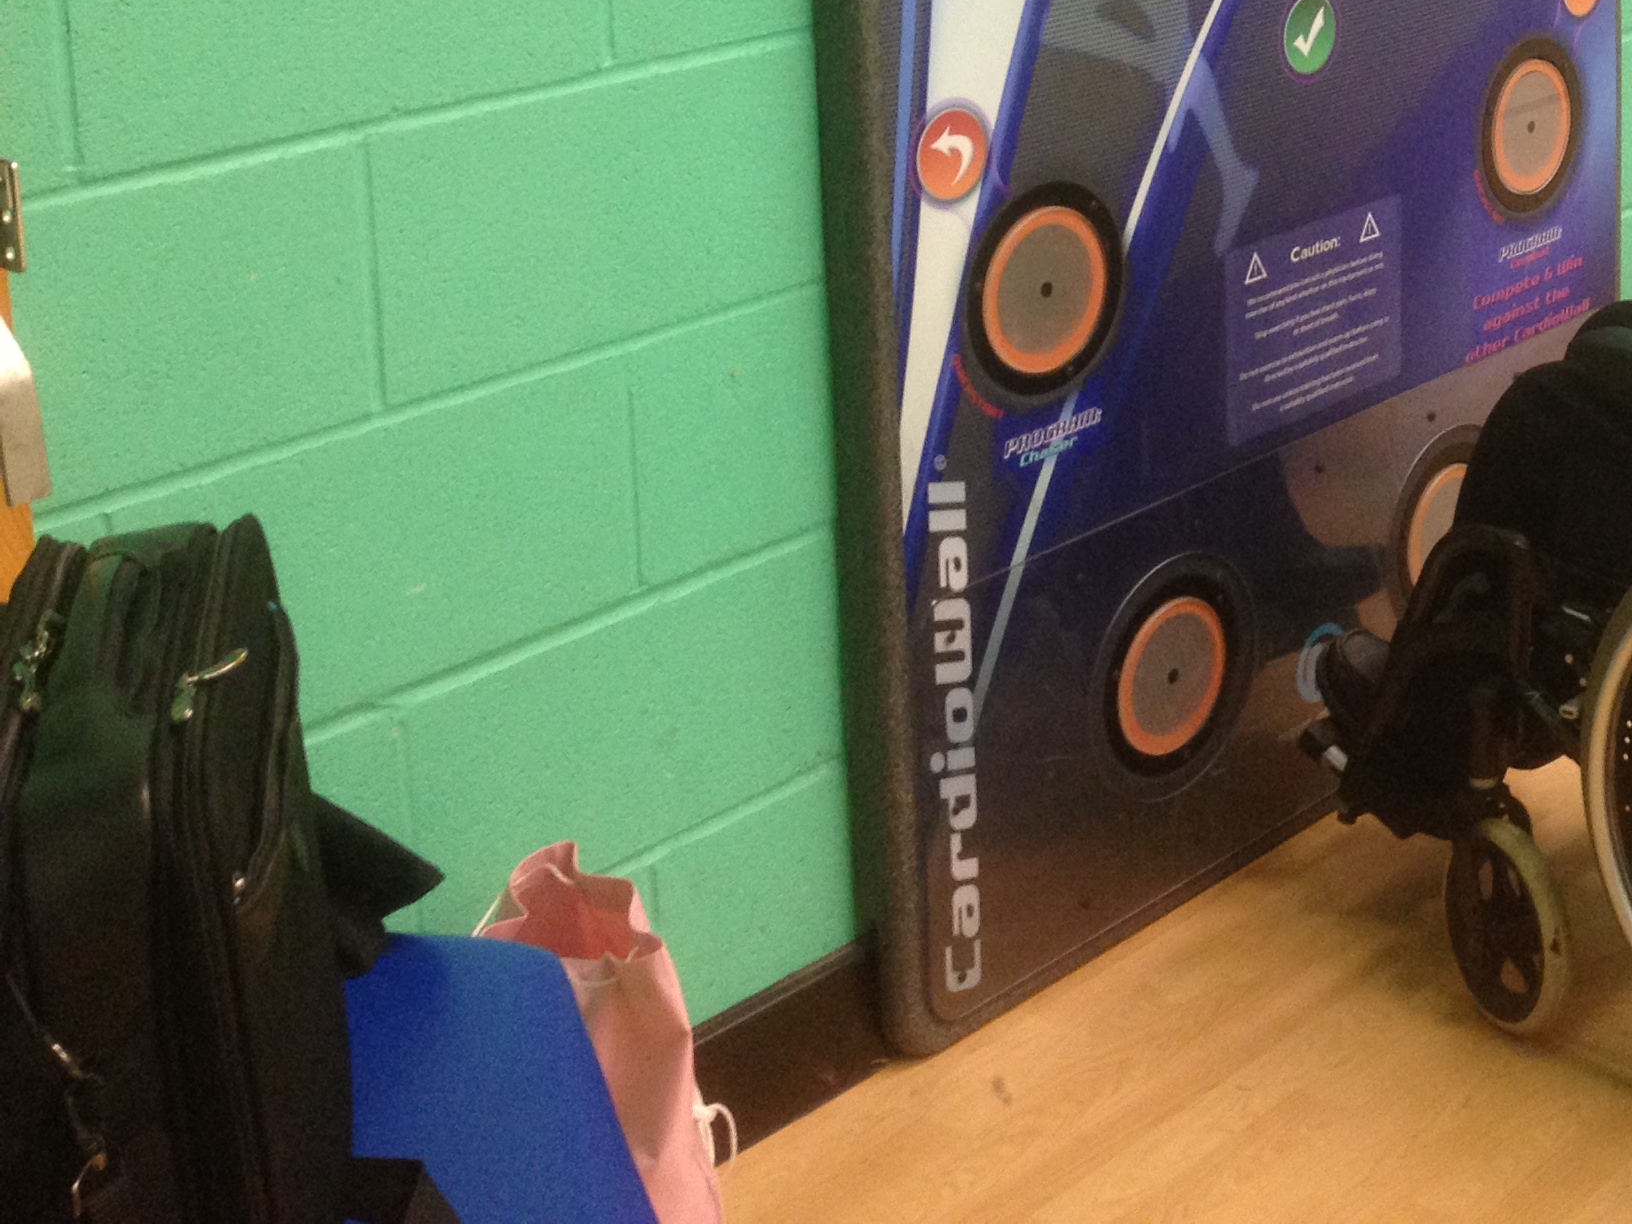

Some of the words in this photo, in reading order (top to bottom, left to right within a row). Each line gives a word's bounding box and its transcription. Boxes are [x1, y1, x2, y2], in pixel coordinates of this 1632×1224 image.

[1290, 236, 1342, 262] Caution:
[1473, 274, 1541, 311] Compete
[1483, 296, 1541, 332] against
[1546, 287, 1571, 305] the
[1466, 335, 1511, 363] other
[1019, 436, 1078, 467] Chaser
[927, 481, 982, 993] CardioWall
